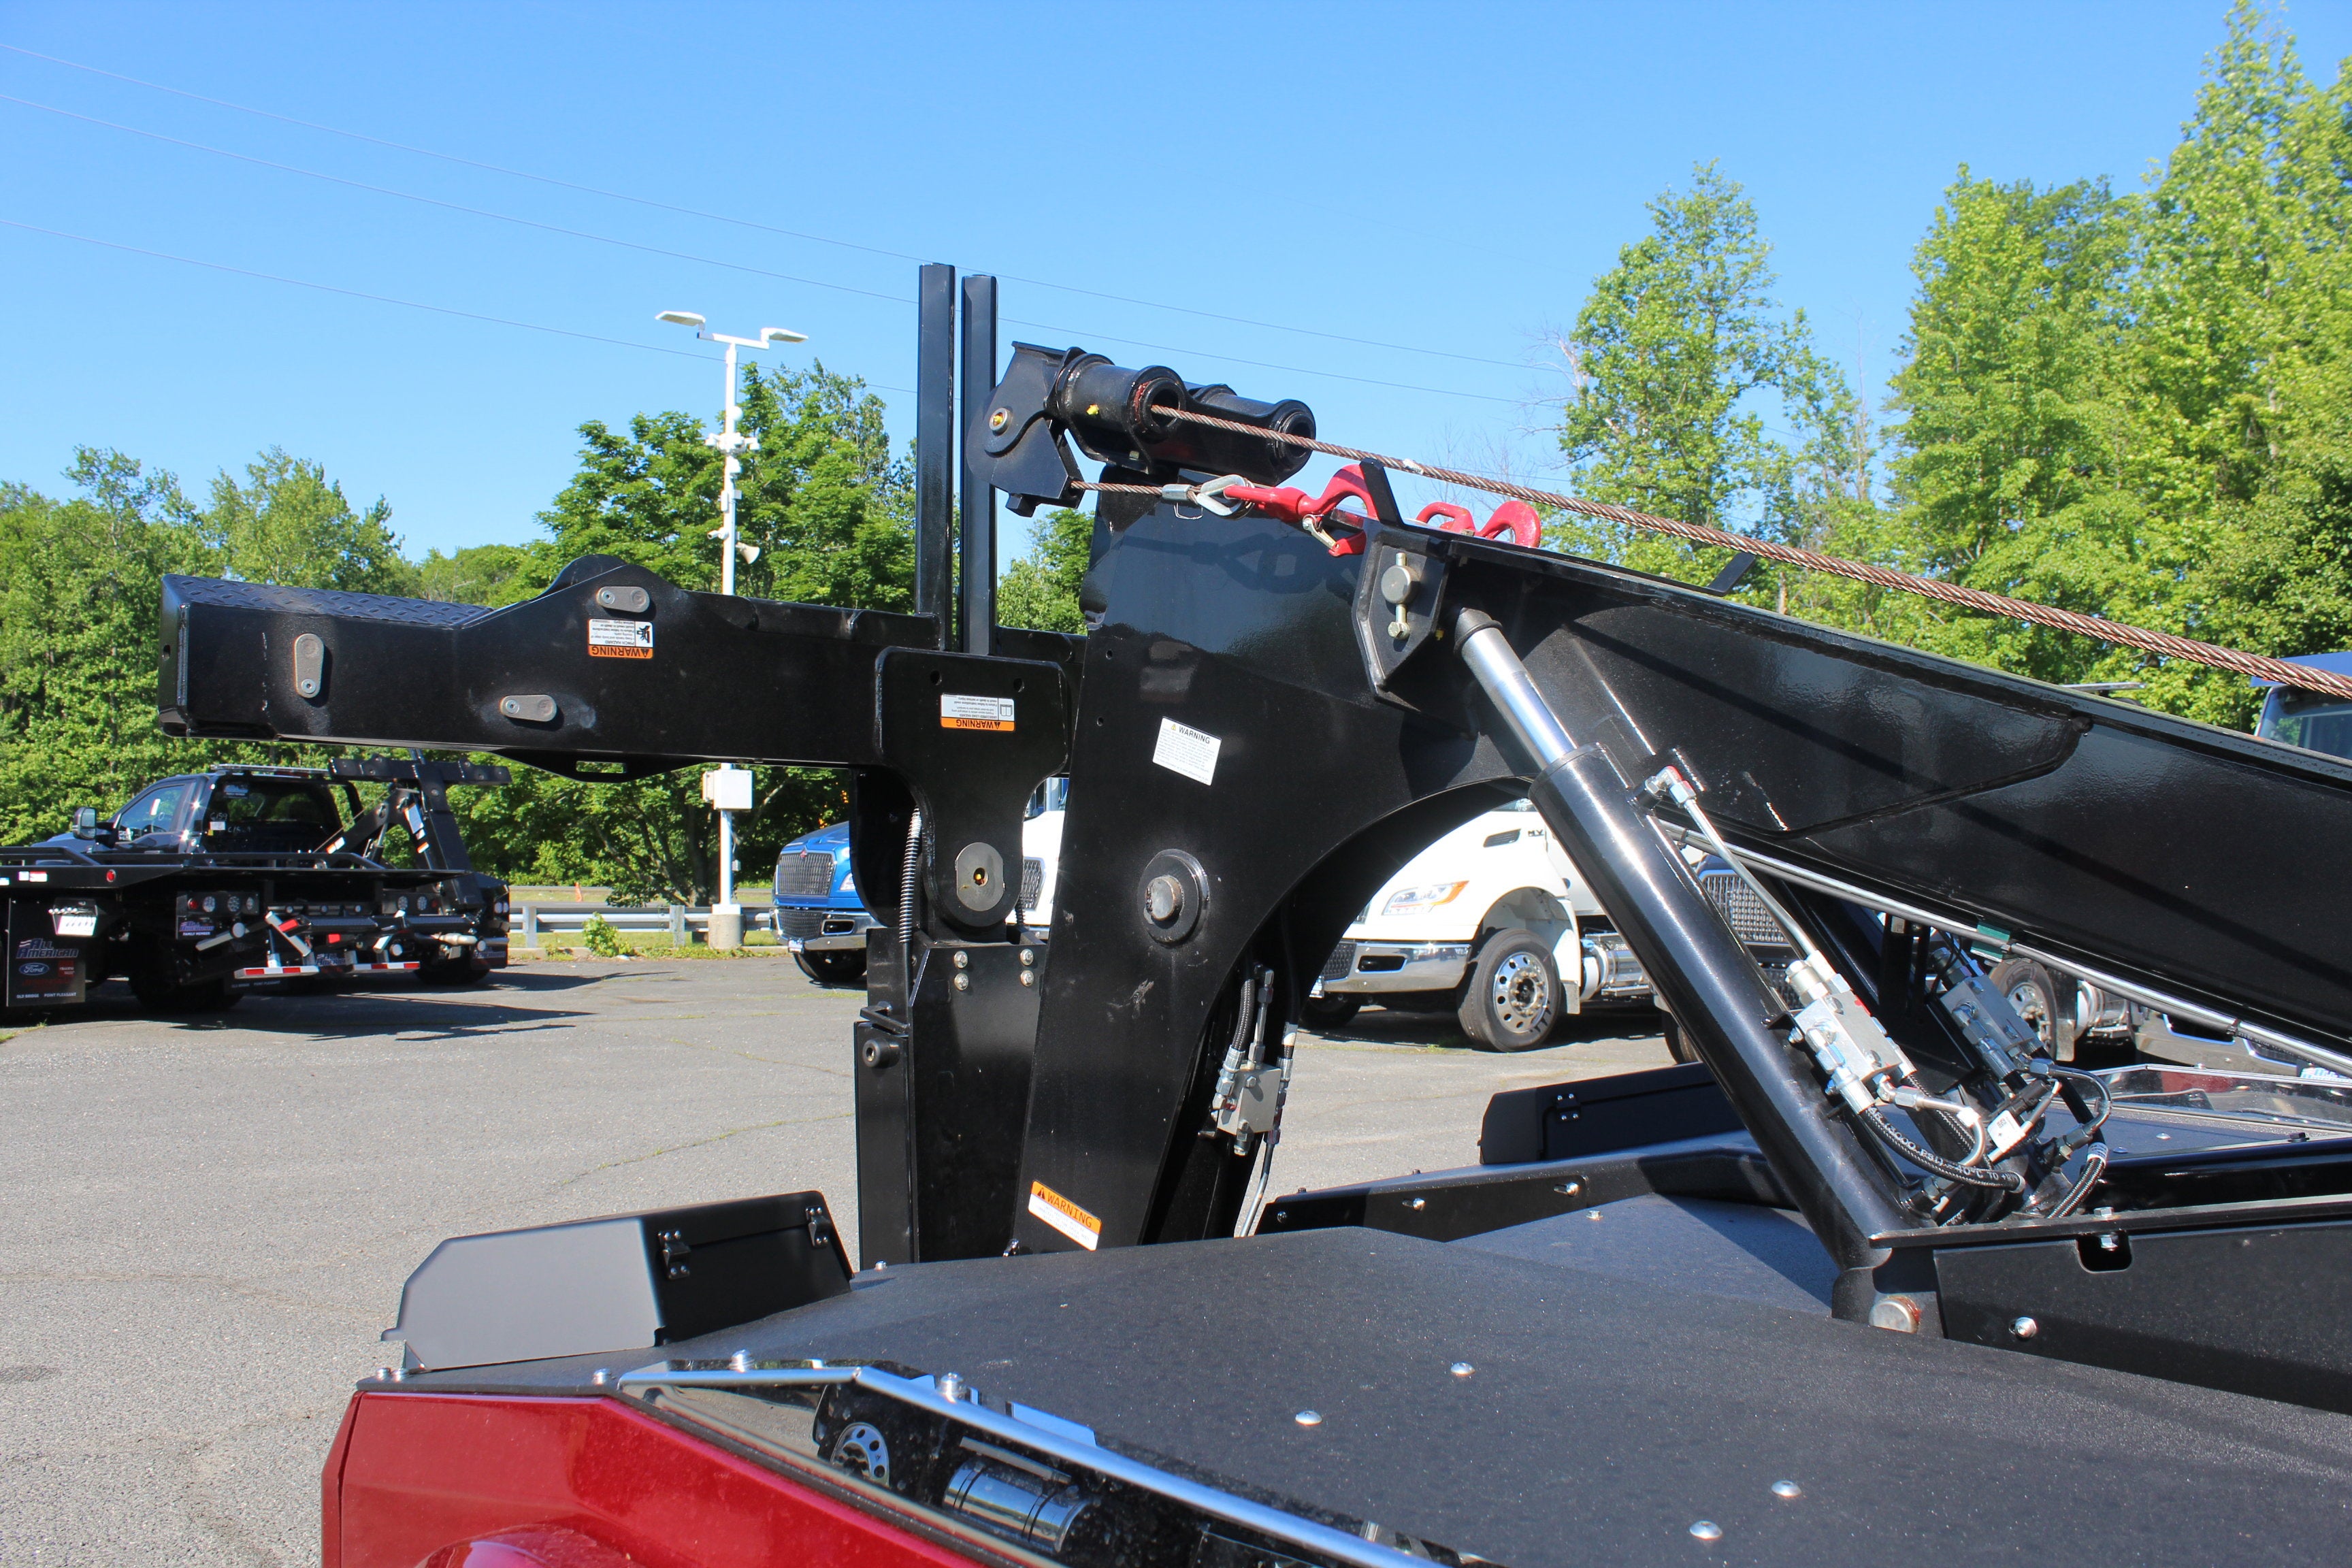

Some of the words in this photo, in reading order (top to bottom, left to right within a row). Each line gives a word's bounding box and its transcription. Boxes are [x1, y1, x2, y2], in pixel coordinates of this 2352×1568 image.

[591, 647, 640, 656] WARNING
[956, 719, 994, 728] WARNING
[1179, 725, 1210, 744] WARNING
[31, 938, 54, 949] ALL
[16, 947, 79, 958] AMERICAN
[24, 965, 45, 973] Ford
[1047, 1192, 1093, 1228] WARNING
